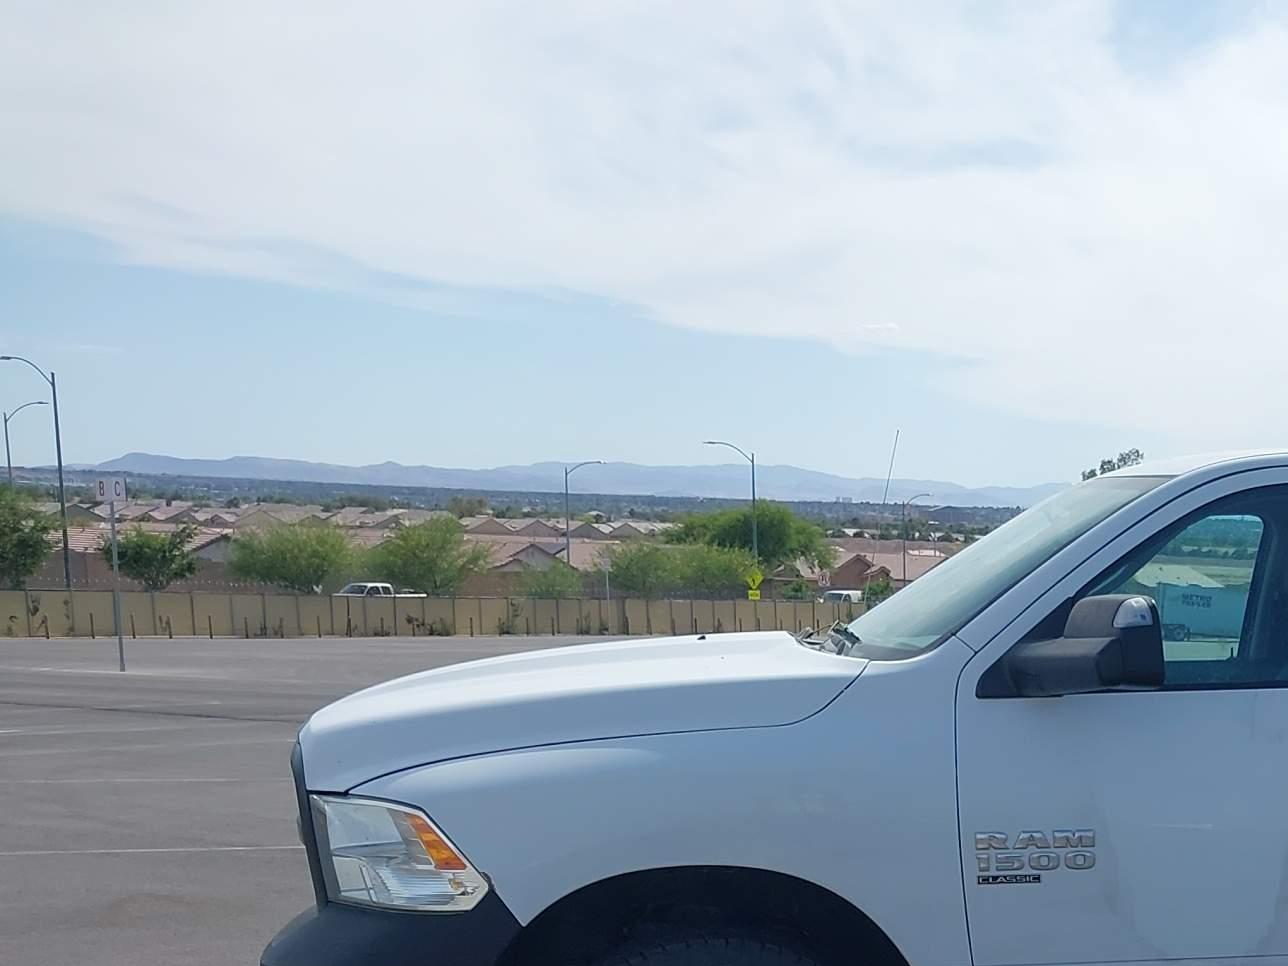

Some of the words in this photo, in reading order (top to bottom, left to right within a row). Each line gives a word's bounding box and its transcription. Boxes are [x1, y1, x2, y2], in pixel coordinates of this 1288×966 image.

[98, 480, 104, 496] B
[114, 480, 121, 496] C
[976, 829, 1096, 850] RAM
[976, 850, 1096, 872] 1500
[979, 874, 1040, 883] CLASSIC
